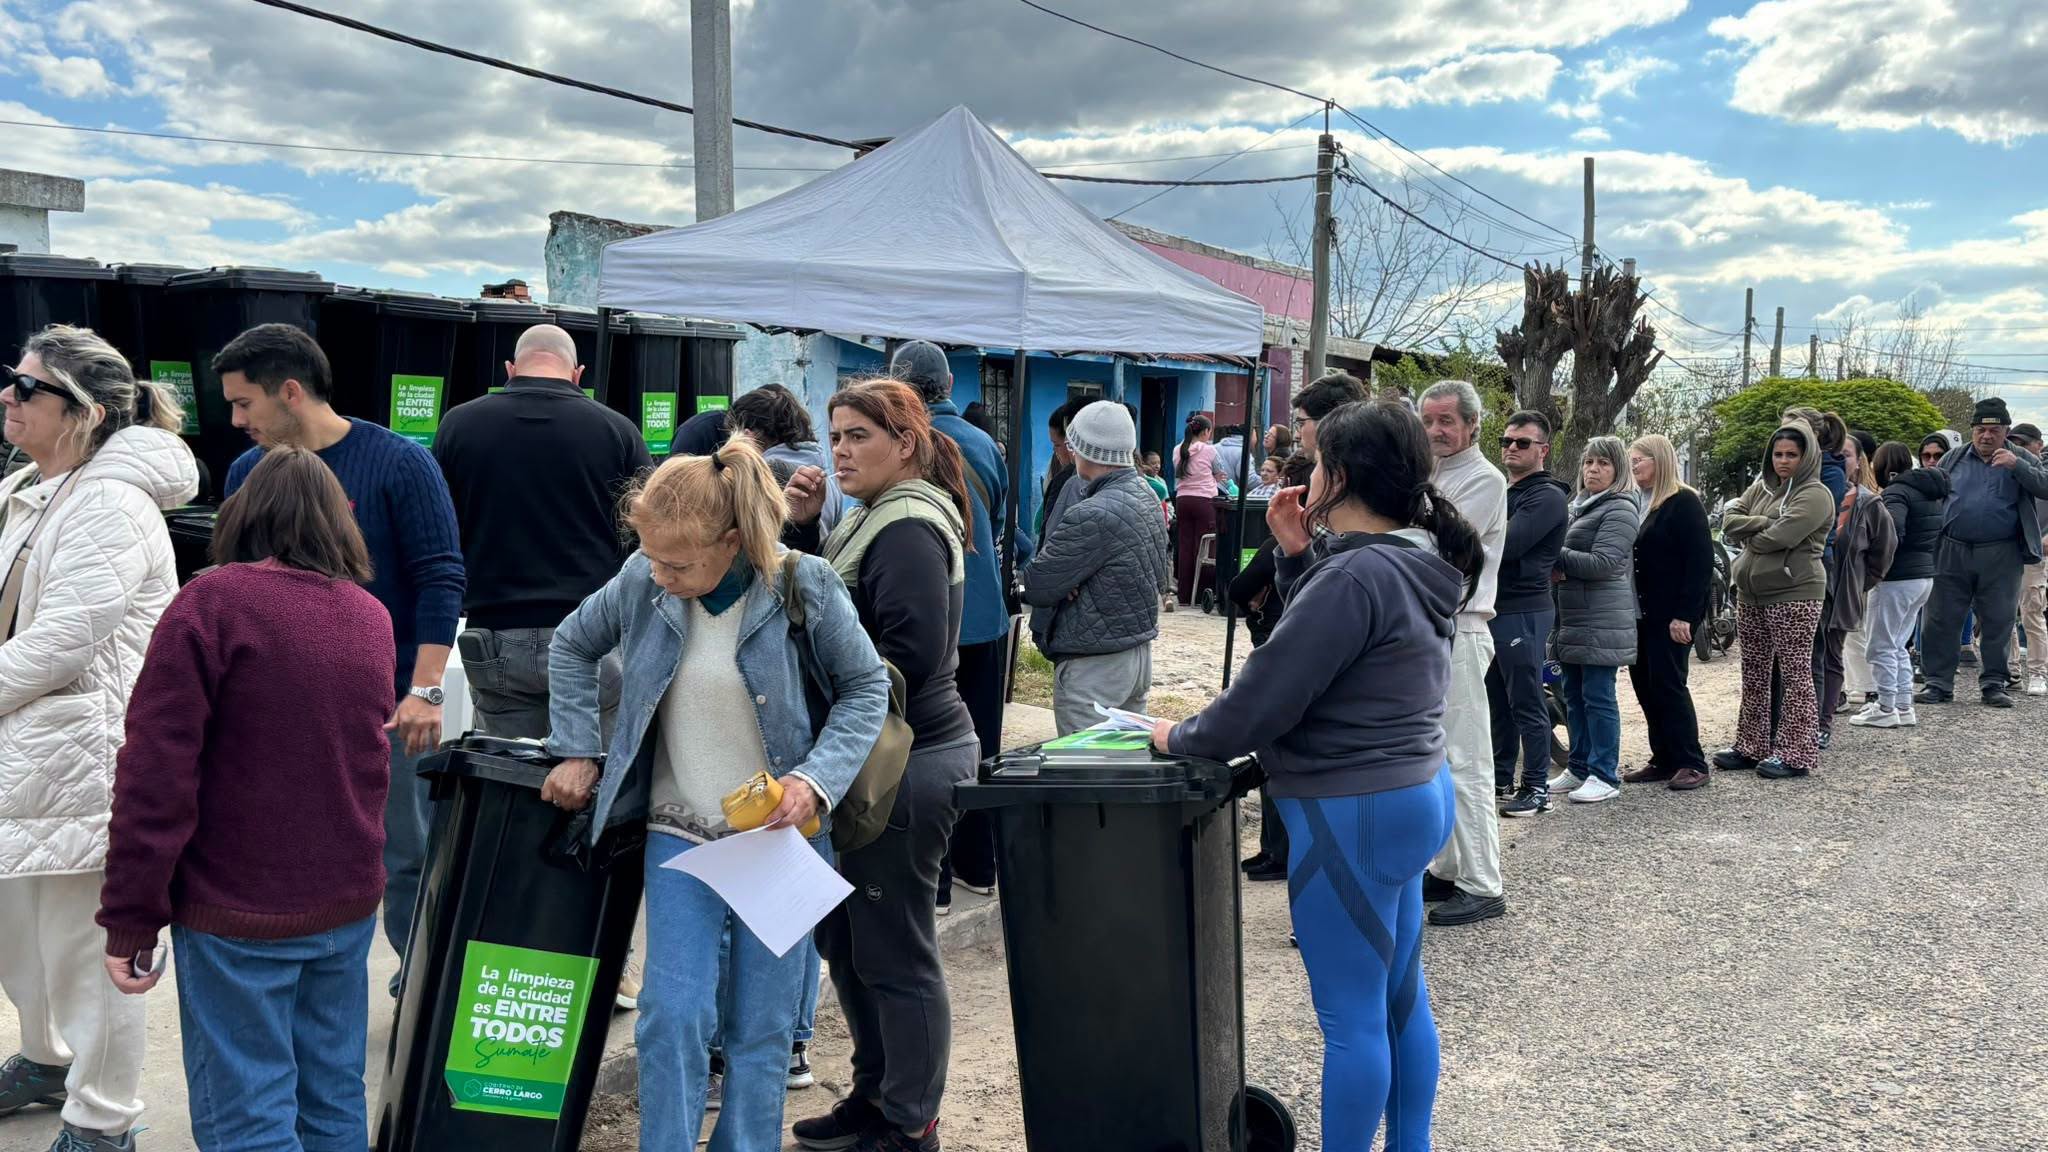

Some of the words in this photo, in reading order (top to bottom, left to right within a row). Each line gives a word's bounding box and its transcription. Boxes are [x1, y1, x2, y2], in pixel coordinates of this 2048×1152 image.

[396, 407, 434, 417] TODOS
[405, 398, 434, 407] ENTRE
[481, 965, 500, 980] La
[508, 968, 575, 990] limpieza
[478, 981, 498, 995] de
[502, 983, 516, 998] la
[518, 986, 572, 1005] ciudad
[473, 1002, 492, 1014] es
[494, 999, 569, 1024] ENTRE
[470, 1016, 566, 1048] TODOS
[475, 1036, 551, 1069] Sumate
[482, 1086, 512, 1097] CERRO
[513, 1090, 543, 1100] LARGO
